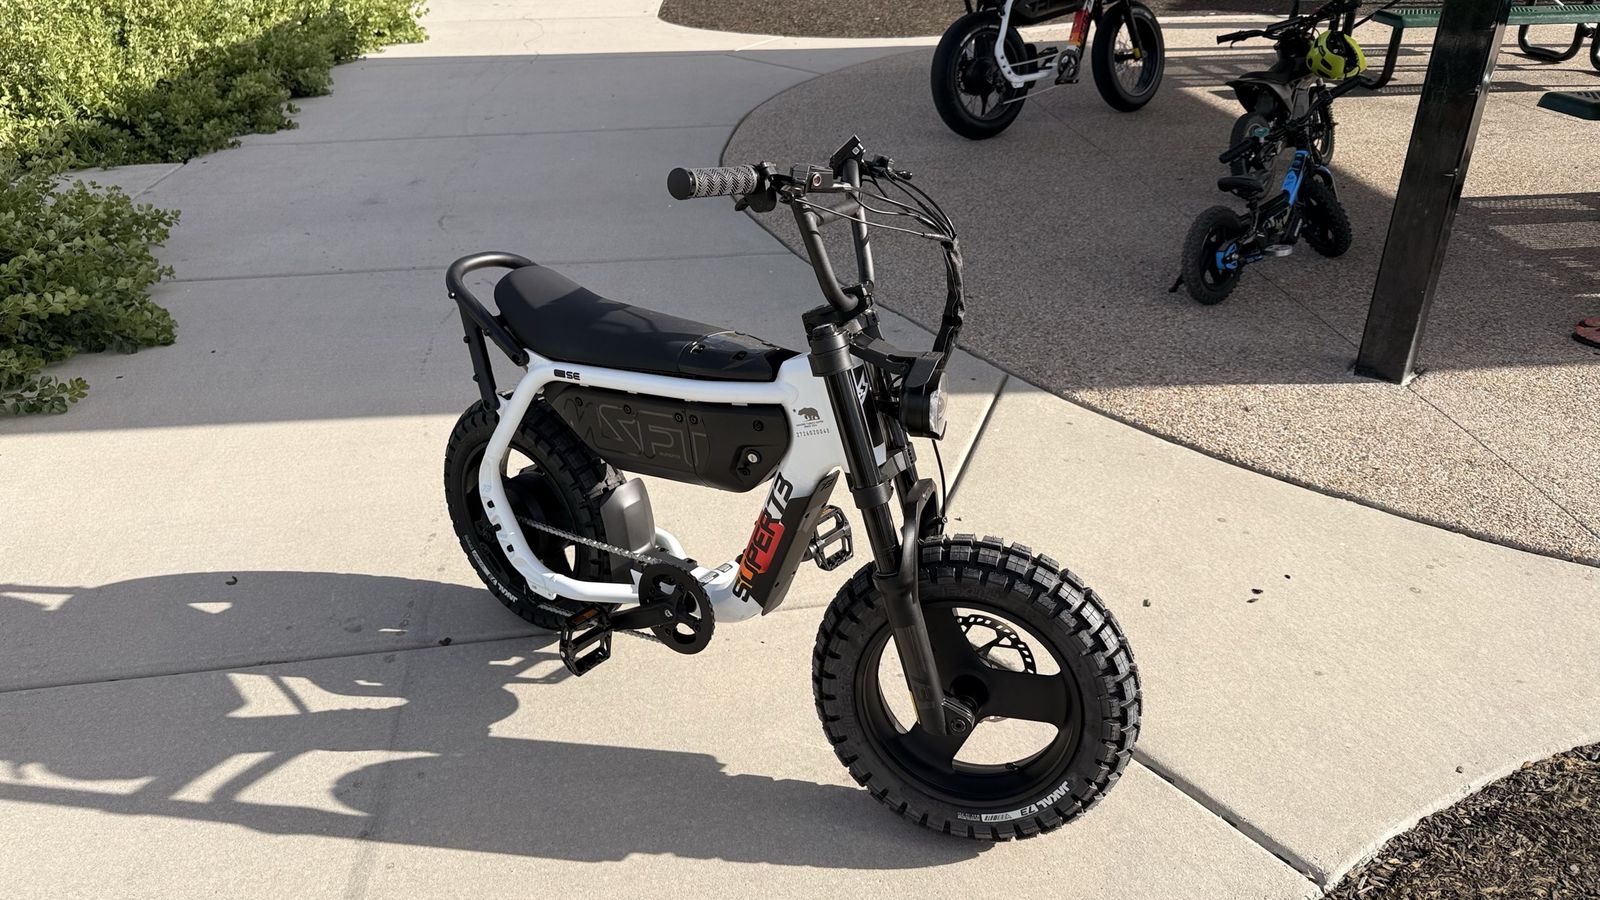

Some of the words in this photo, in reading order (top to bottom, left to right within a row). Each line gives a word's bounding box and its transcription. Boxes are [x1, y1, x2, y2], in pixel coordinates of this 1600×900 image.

[566, 370, 581, 381] SE
[733, 472, 793, 603] SUPER73
[1036, 781, 1070, 807] JAKAL
[1020, 805, 1035, 817] 73
